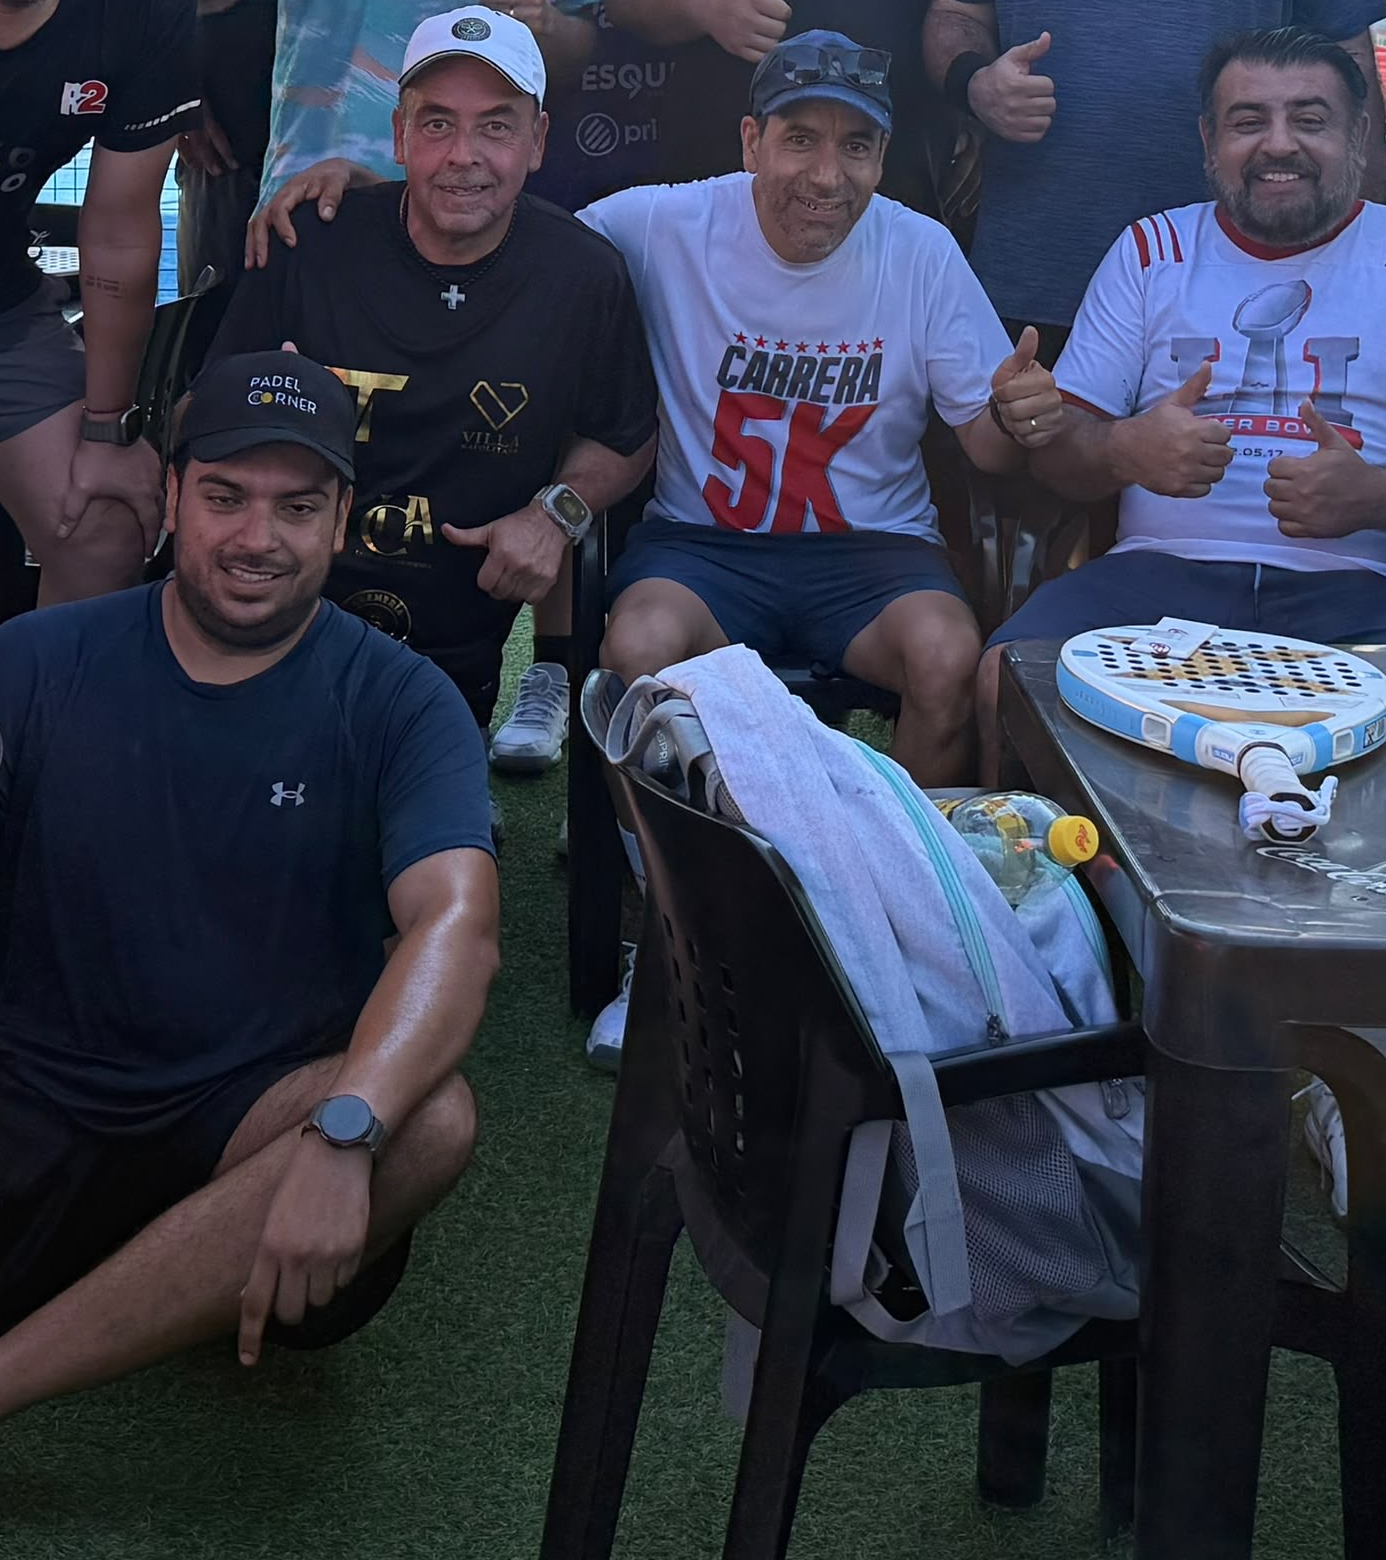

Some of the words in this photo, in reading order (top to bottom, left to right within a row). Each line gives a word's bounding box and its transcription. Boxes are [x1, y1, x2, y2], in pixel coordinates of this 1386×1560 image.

[60, 79, 109, 116] R2
[250, 375, 301, 393] PADEL
[716, 344, 883, 405] CARRERA
[702, 389, 880, 535] 5K
